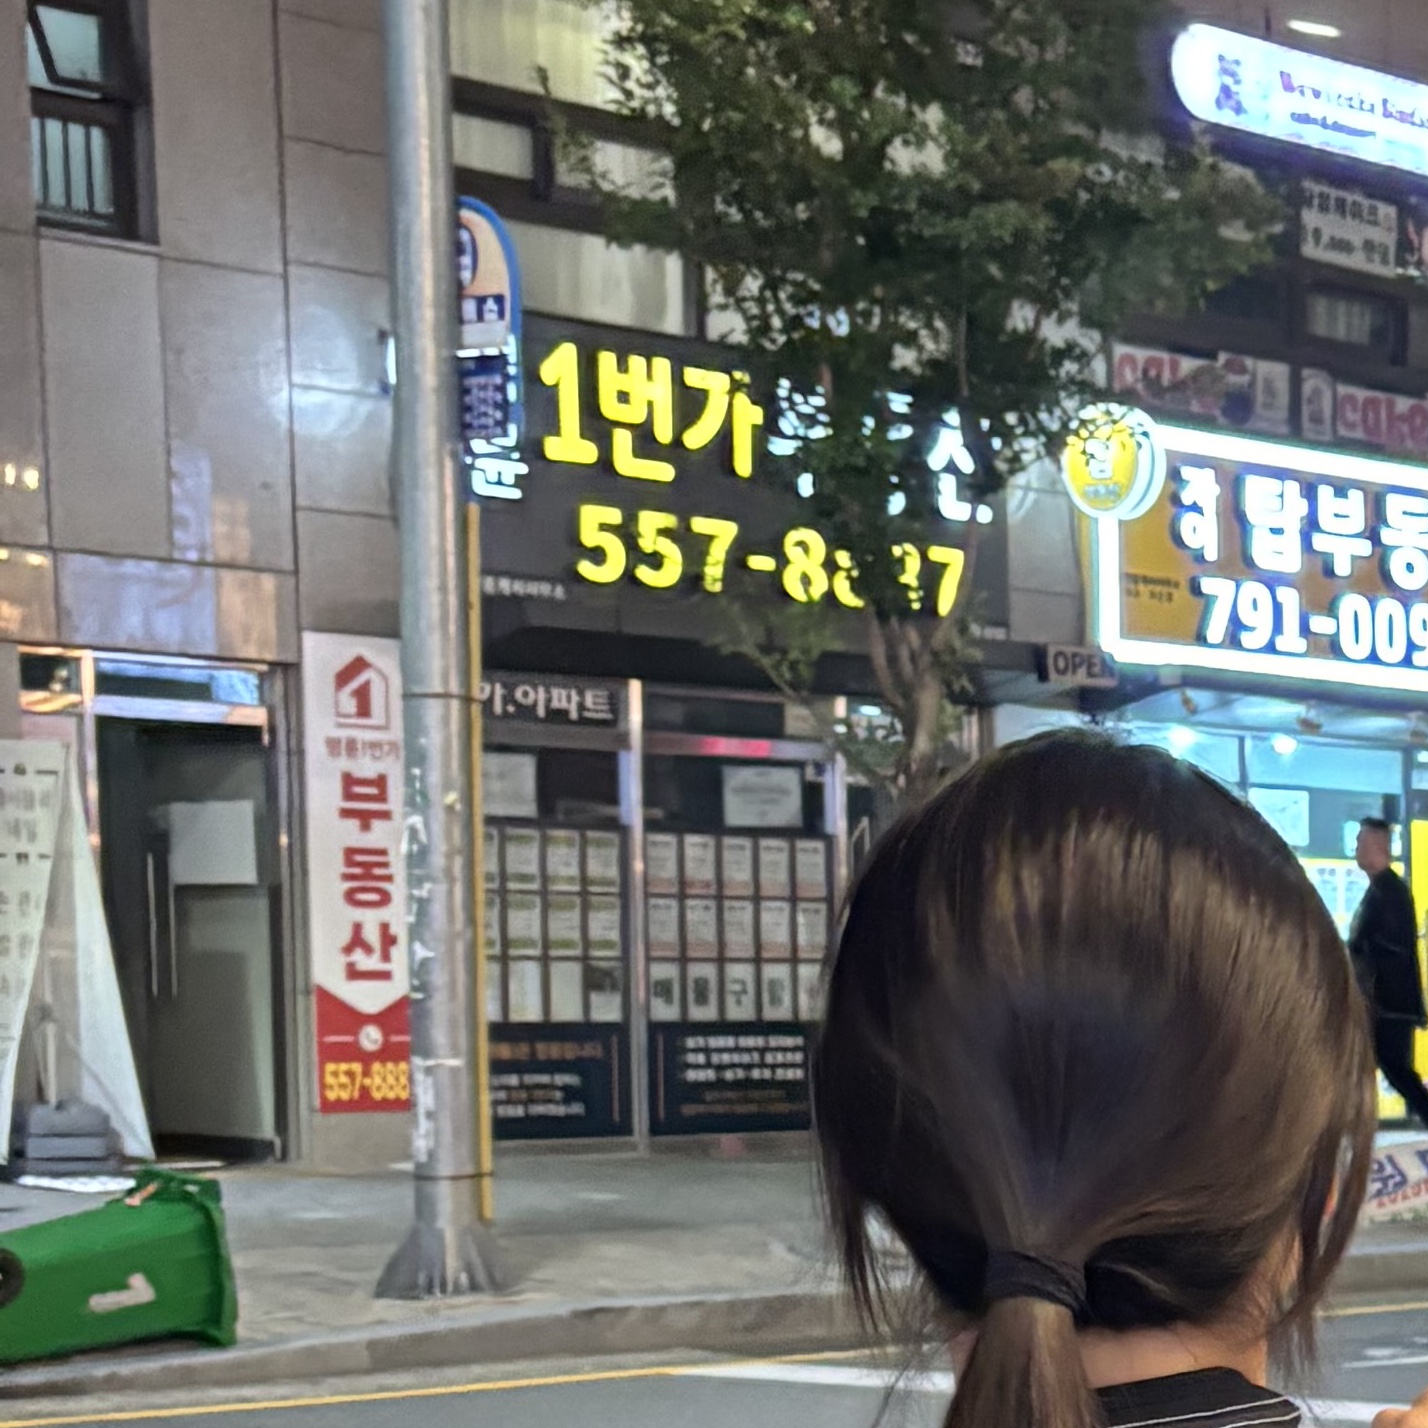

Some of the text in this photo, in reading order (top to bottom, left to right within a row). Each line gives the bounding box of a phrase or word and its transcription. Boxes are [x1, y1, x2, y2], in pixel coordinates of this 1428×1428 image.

[540, 341, 764, 483] 1번가
[1178, 466, 1220, 562] 자이
[1053, 651, 1113, 680] OPE
[338, 772, 398, 982] 부동산
[324, 1061, 410, 1101] 557-888
